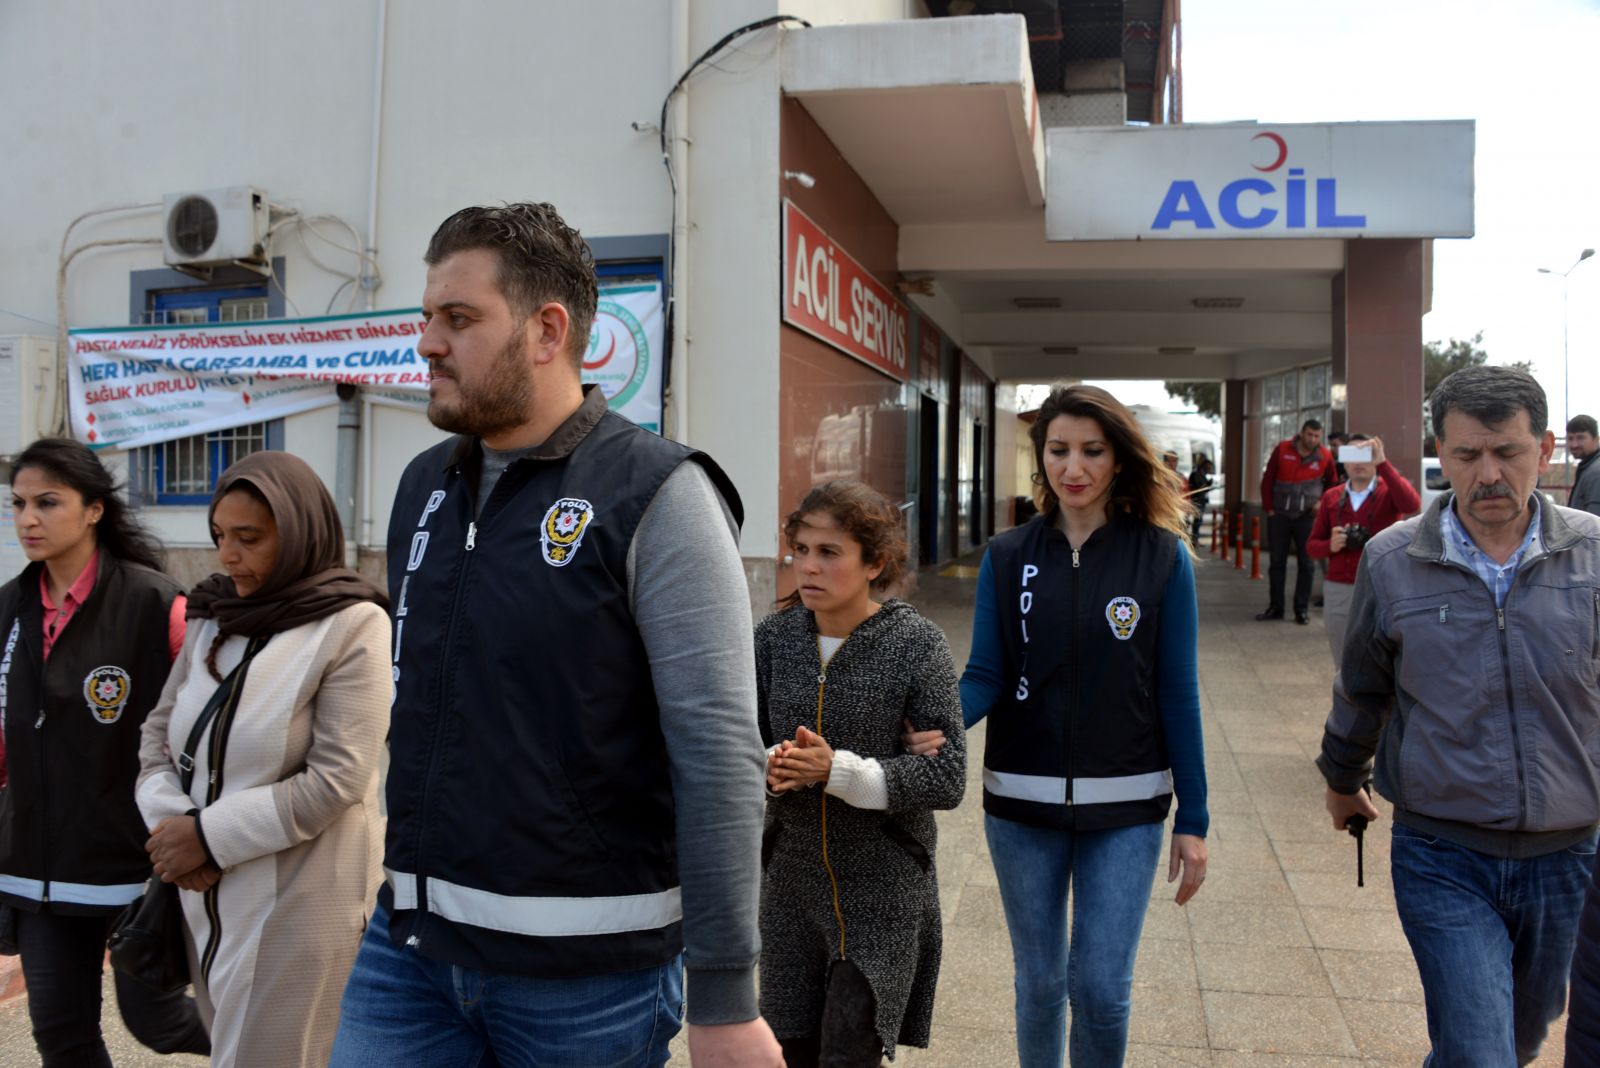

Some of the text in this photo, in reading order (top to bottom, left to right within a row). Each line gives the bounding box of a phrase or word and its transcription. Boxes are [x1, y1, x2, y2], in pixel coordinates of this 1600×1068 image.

[1151, 168, 1366, 230] ACİL
[792, 234, 906, 370] ACİL SERVİS
[76, 333, 167, 354] HASTANEMİZ
[267, 333, 291, 345] EK
[290, 327, 353, 345] HİZMET
[356, 322, 417, 340] BİNASI
[80, 362, 119, 383] HER
[315, 357, 340, 368] ve
[344, 348, 416, 367] CUMA
[85, 384, 132, 405] SAĞLIK
[135, 376, 197, 397] KURULU
[310, 372, 396, 385] VERMEYE
[1016, 564, 1039, 701] POLS
